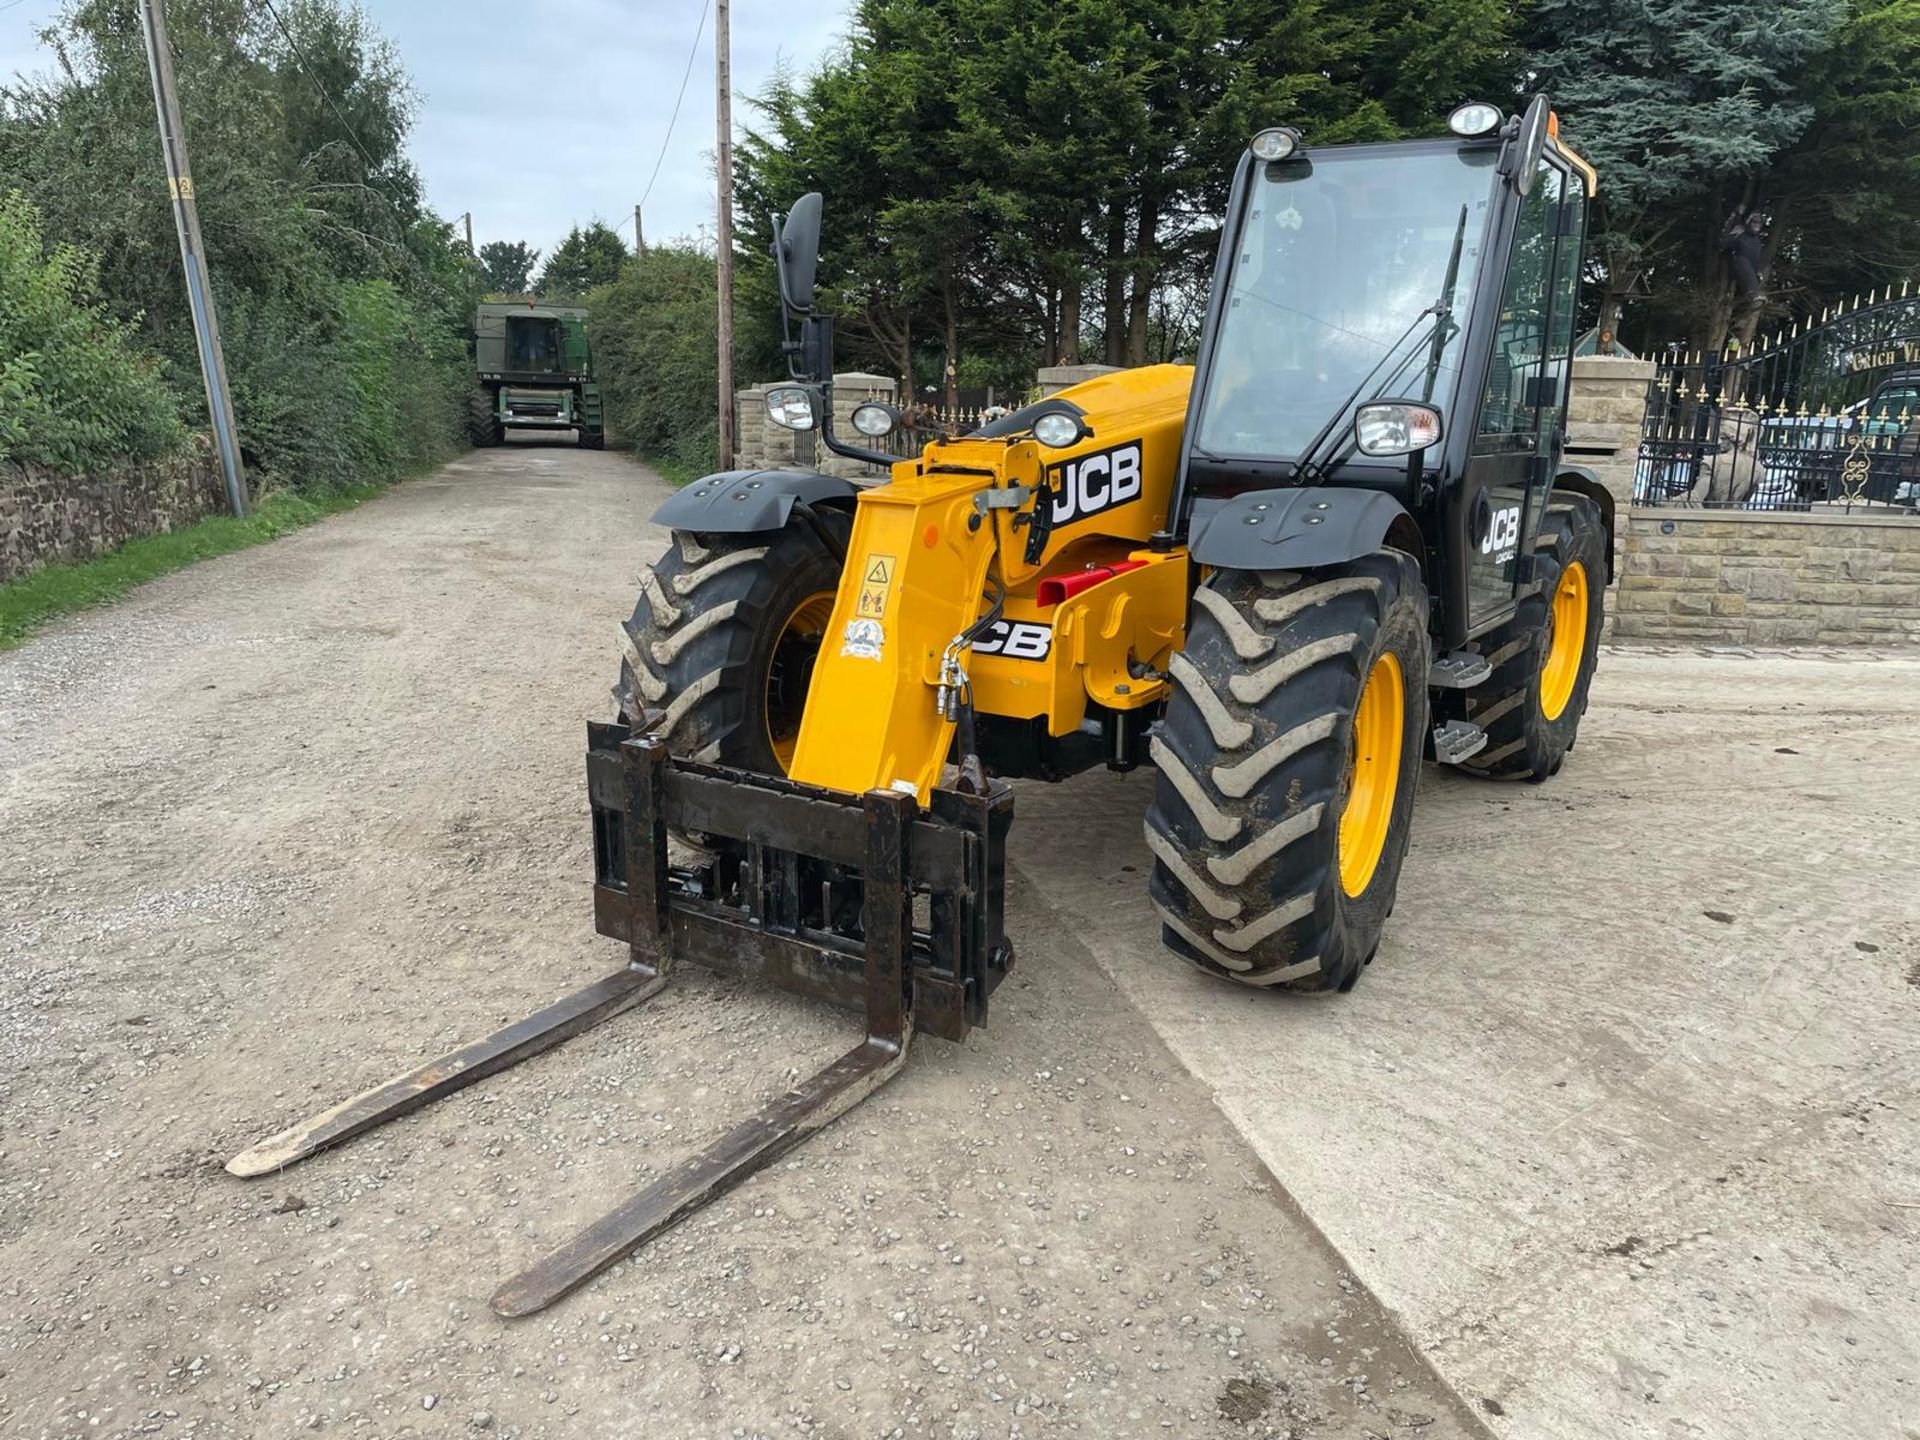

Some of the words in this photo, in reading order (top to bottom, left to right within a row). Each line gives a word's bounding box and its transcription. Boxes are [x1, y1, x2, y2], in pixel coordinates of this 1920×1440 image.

[1904, 342, 1920, 363] VI
[1052, 446, 1140, 523] JCB
[1482, 507, 1519, 554] JCB
[972, 620, 1052, 658] CB
